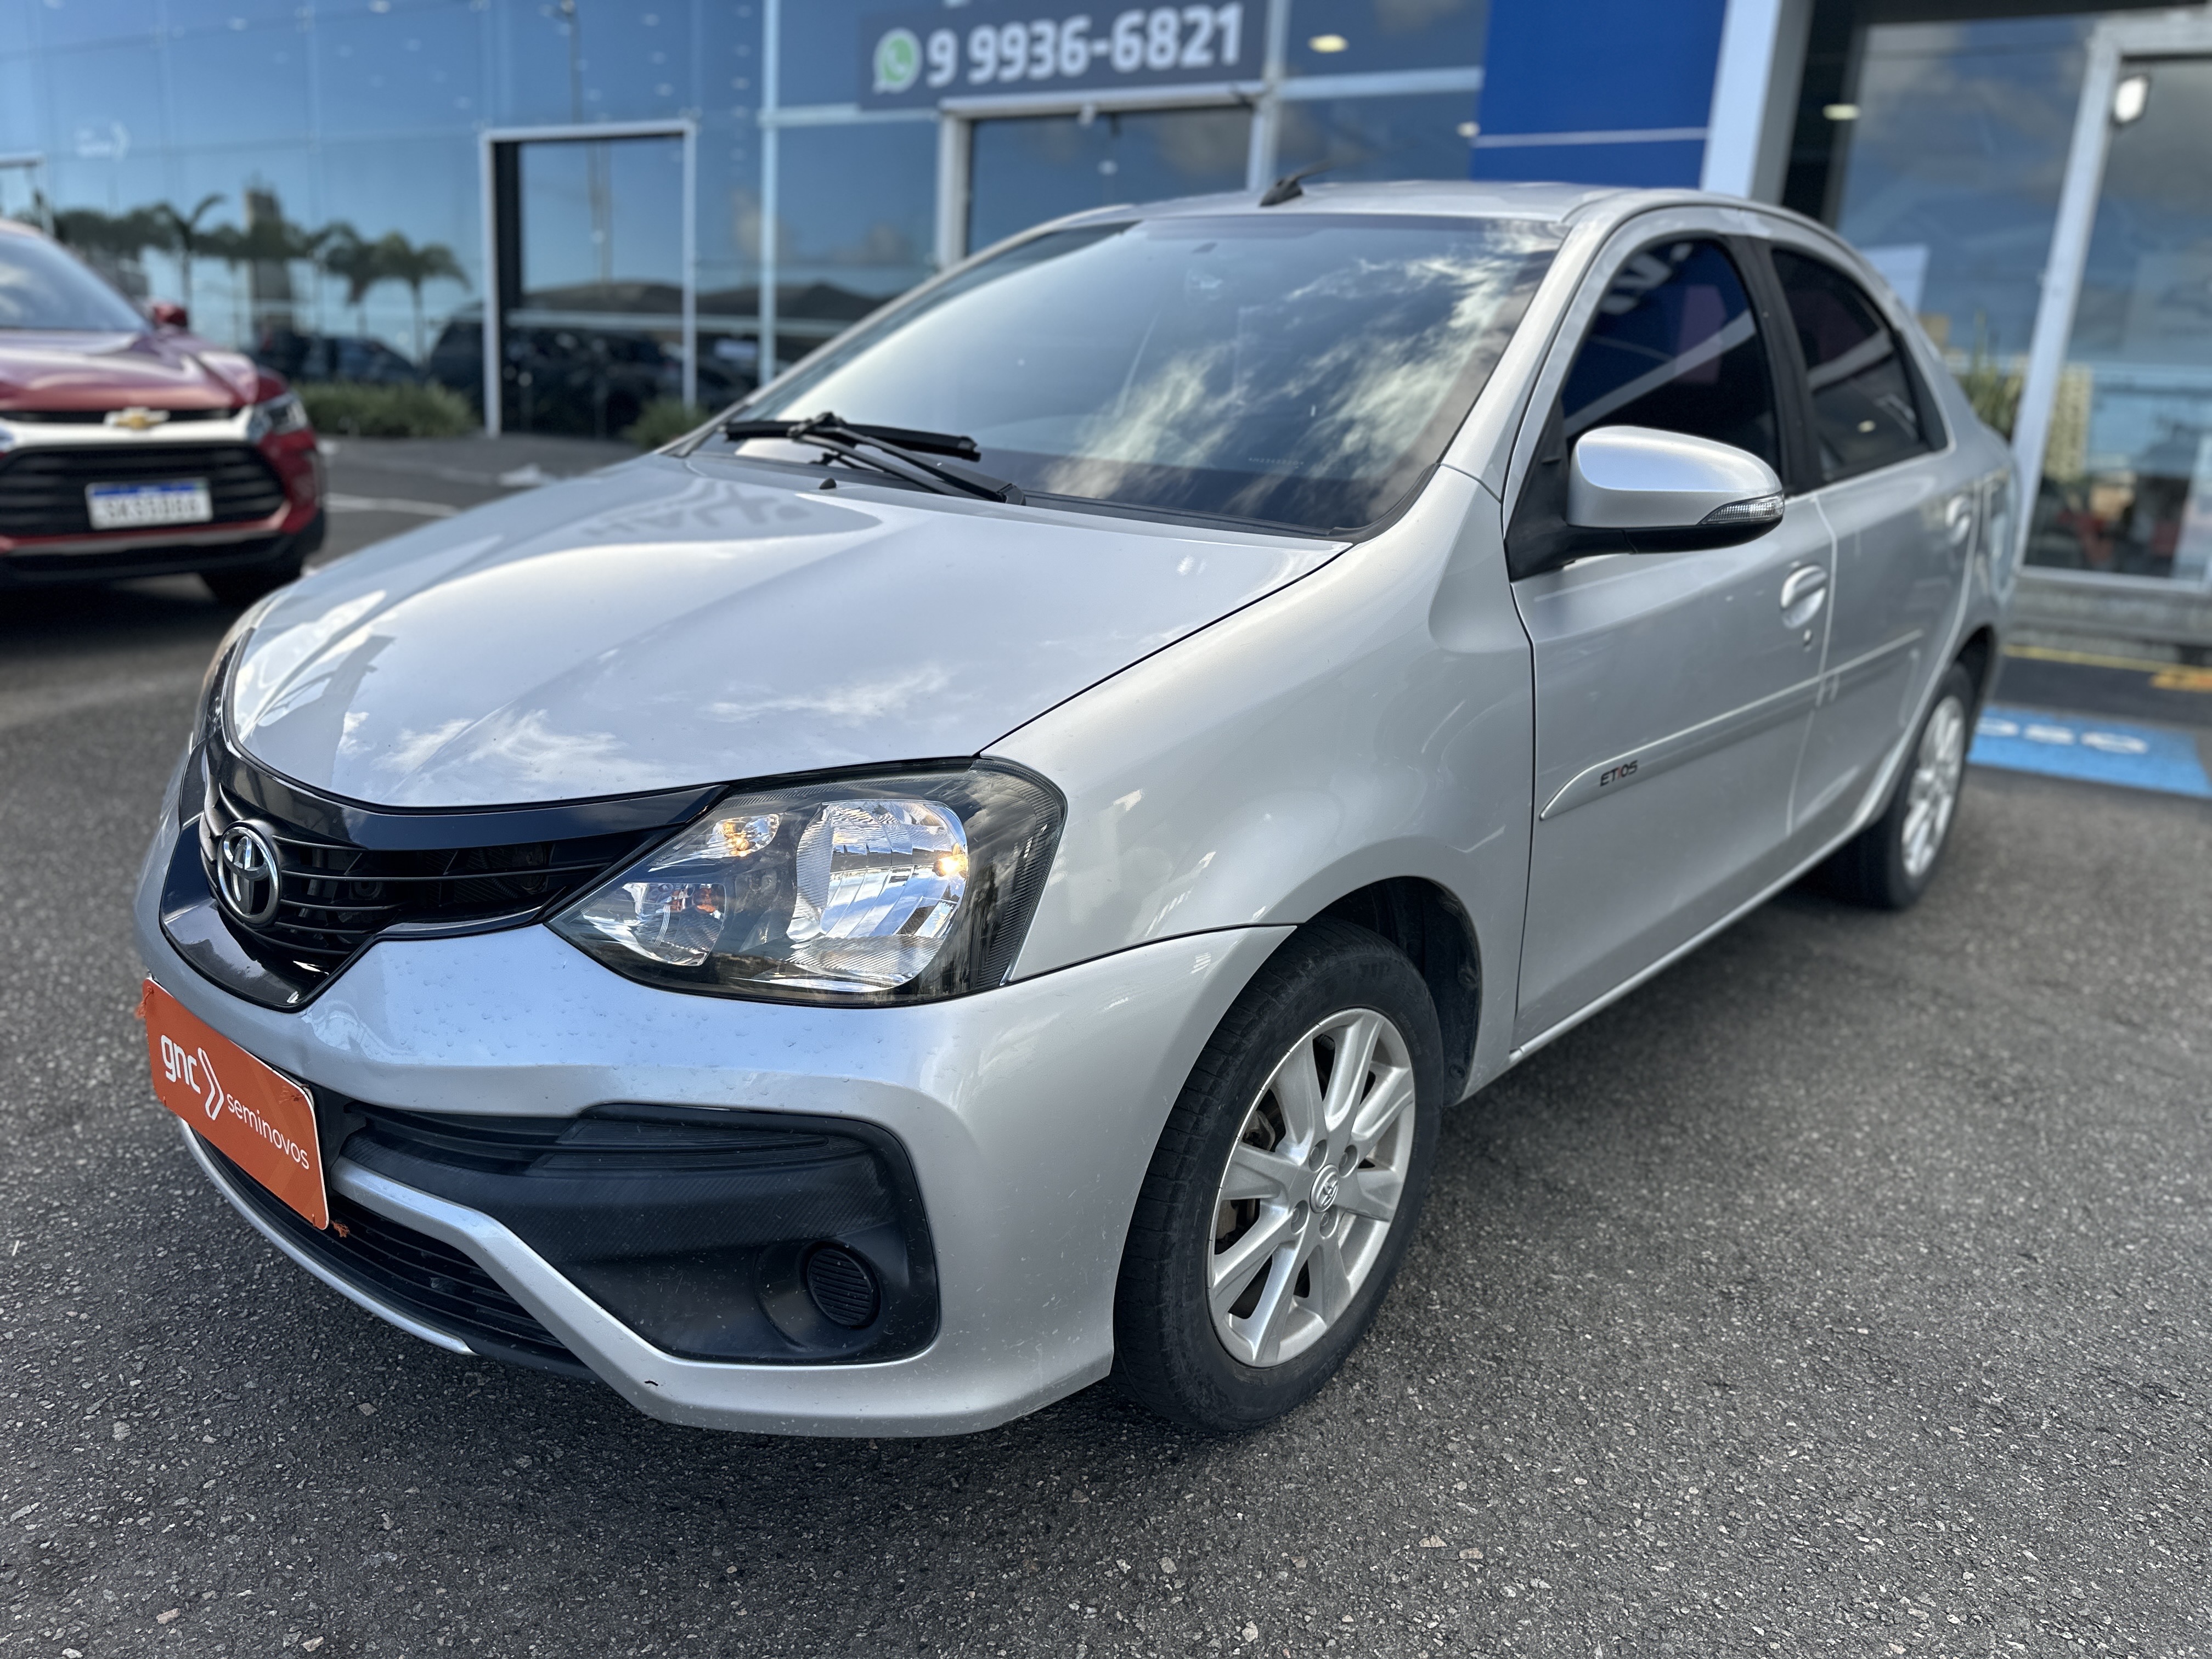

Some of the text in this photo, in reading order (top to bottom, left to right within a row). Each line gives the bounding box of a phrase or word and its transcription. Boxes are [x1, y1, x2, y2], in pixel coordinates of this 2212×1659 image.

[926, 3, 1242, 87] 9 9936-6821
[1599, 759, 1638, 787] ETIOS
[160, 1034, 201, 1094] gnc
[226, 1093, 310, 1170] seminovos
